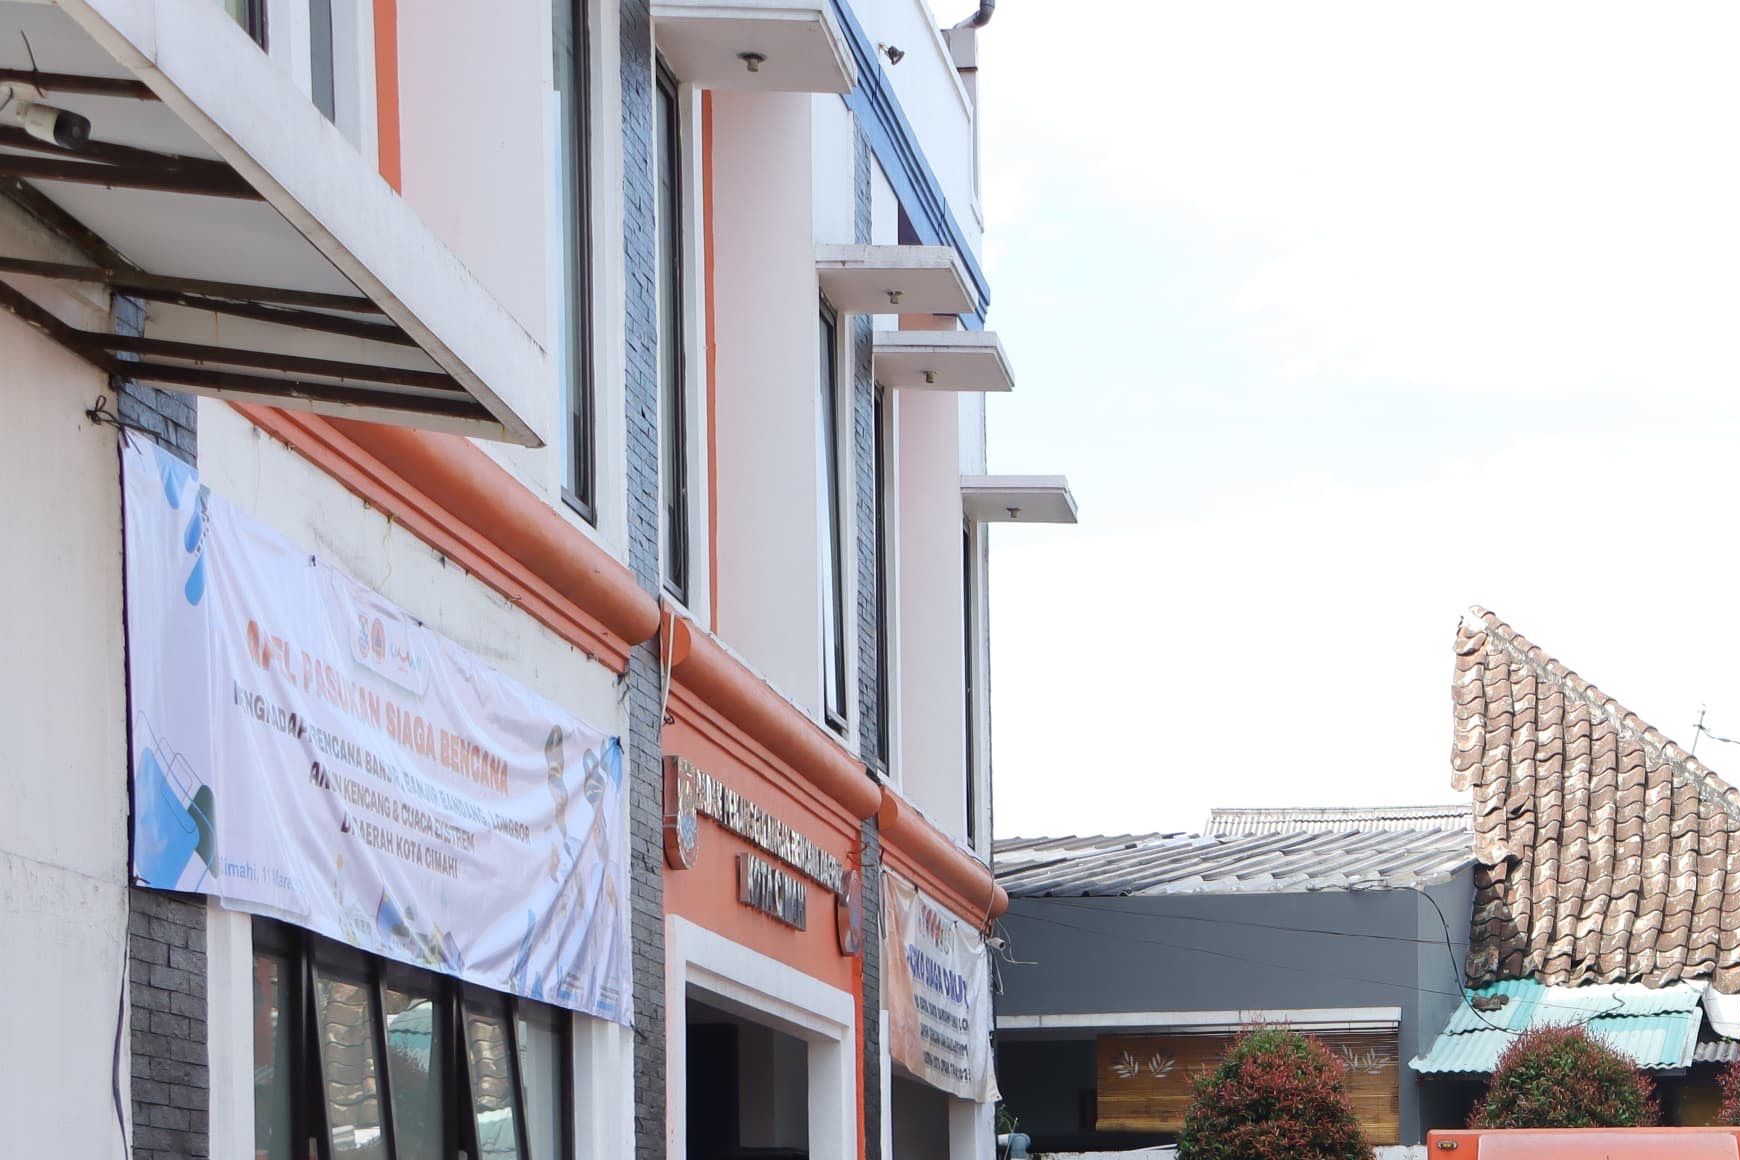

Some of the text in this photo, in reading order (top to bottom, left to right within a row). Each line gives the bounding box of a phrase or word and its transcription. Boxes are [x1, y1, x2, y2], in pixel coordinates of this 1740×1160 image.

[385, 701, 436, 761] SIAGA
[440, 728, 510, 797] BENCANA
[344, 777, 390, 819] KENCANG
[392, 799, 400, 824] &
[401, 803, 433, 836] CUACA
[396, 835, 422, 863] KOTA
[425, 847, 458, 878] CIMAHI
